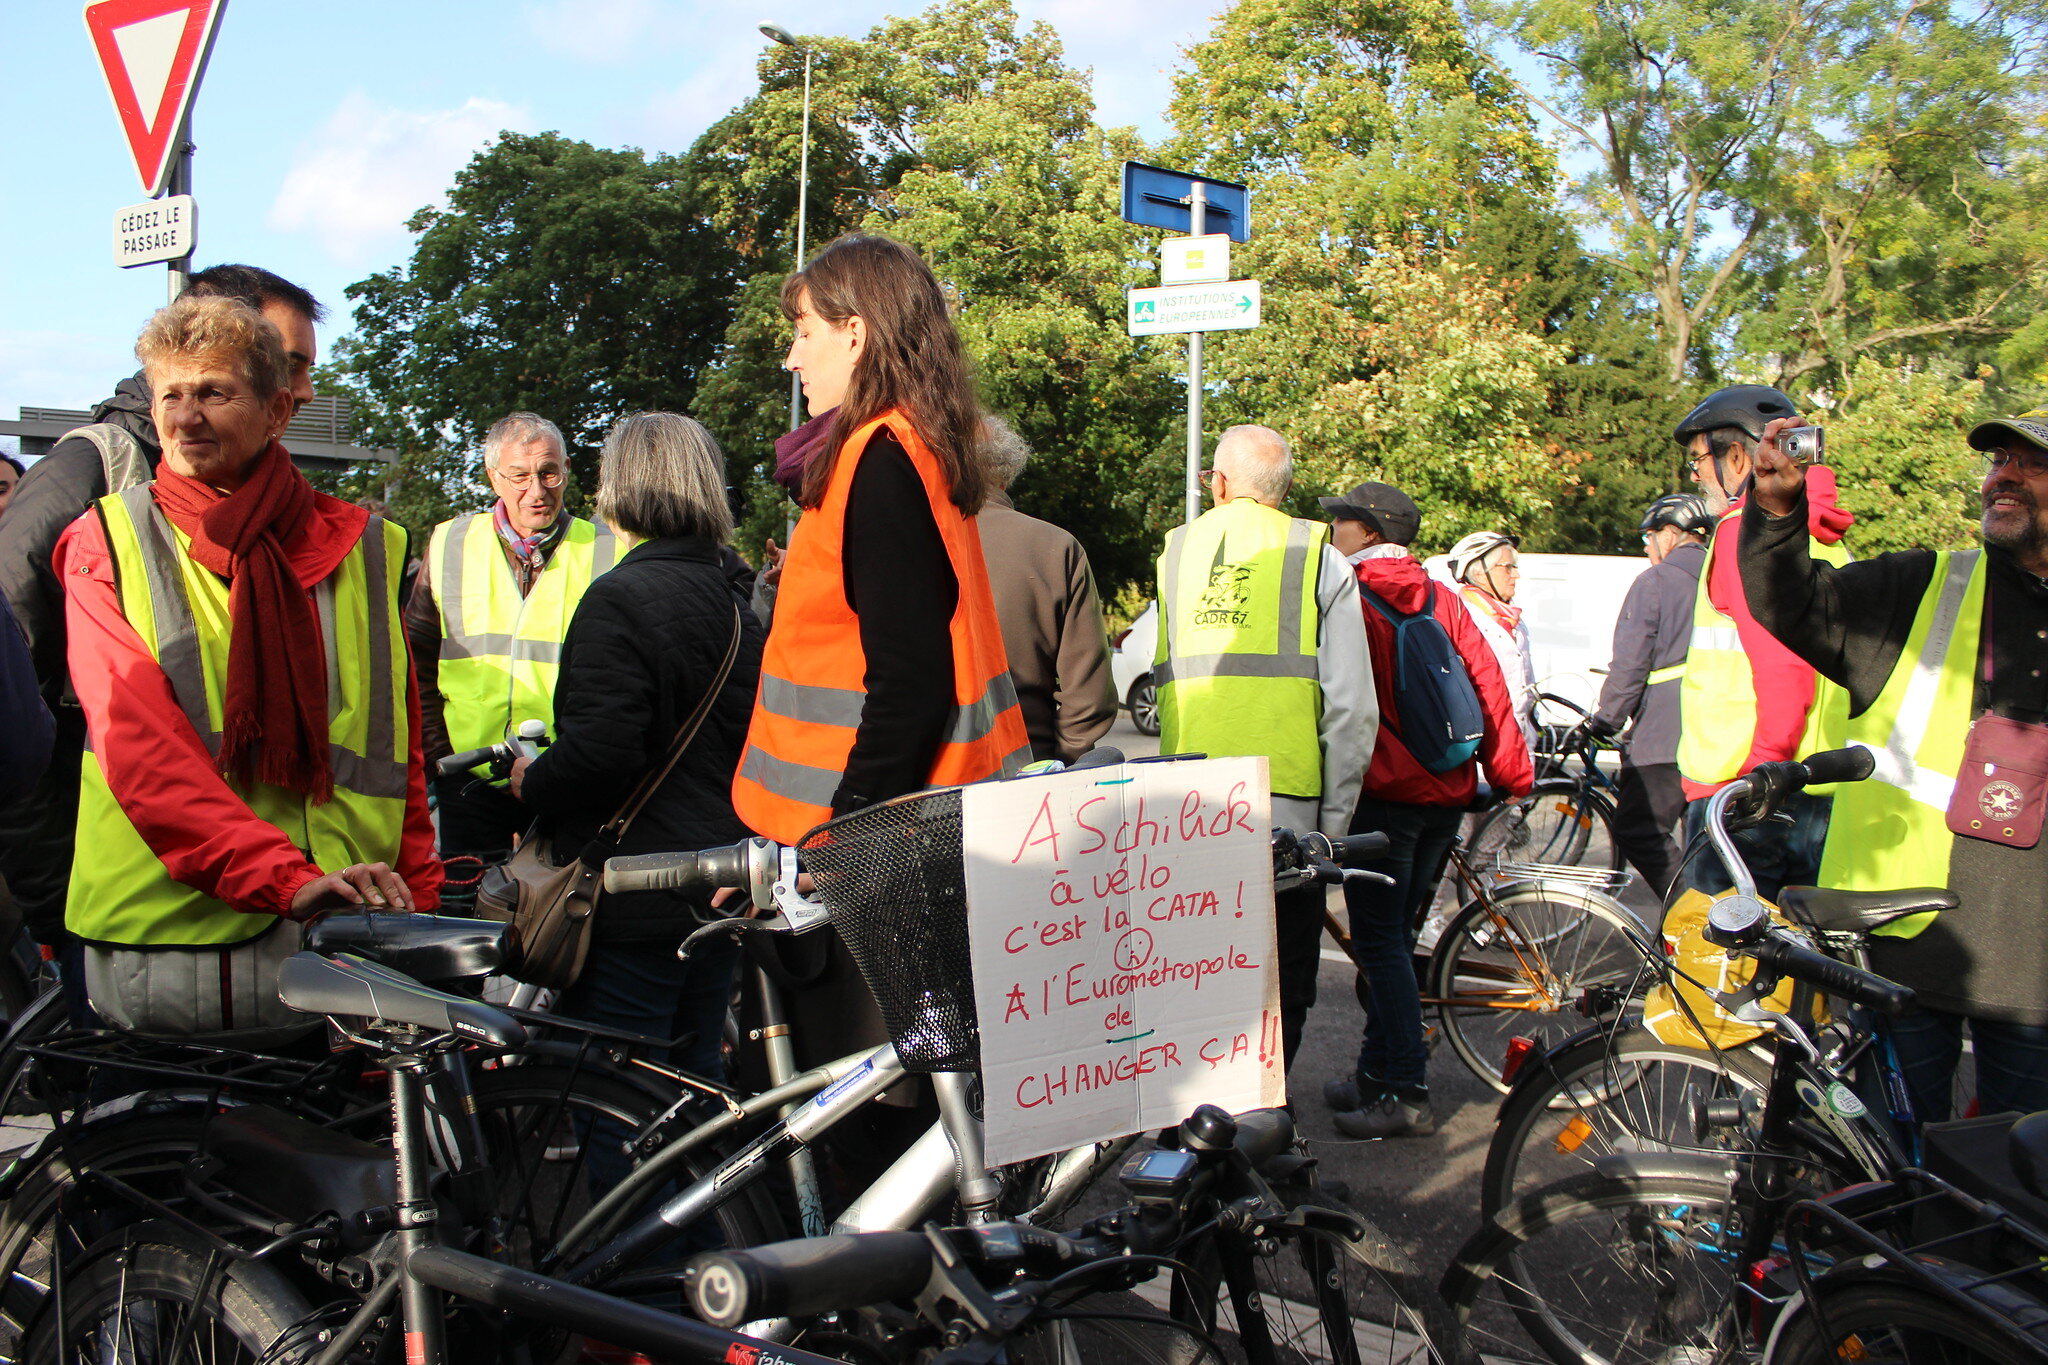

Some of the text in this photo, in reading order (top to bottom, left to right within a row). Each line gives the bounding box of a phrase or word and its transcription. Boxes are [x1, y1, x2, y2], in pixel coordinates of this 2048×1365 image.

[121, 206, 180, 233] CÉDEZ LE
[124, 230, 177, 255] PASSAGE
[1160, 292, 1236, 307] INSTITUTIONS
[1160, 308, 1237, 324] EUROPEENNES
[1194, 613, 1248, 625] CADR 67
[1011, 780, 1256, 864] A Schilick
[1093, 853, 1172, 899] vélo
[1104, 906, 1130, 933] la
[1004, 984, 1031, 1024] A
[1104, 1002, 1134, 1031] de
[1016, 1042, 1182, 1110] CHANGER
